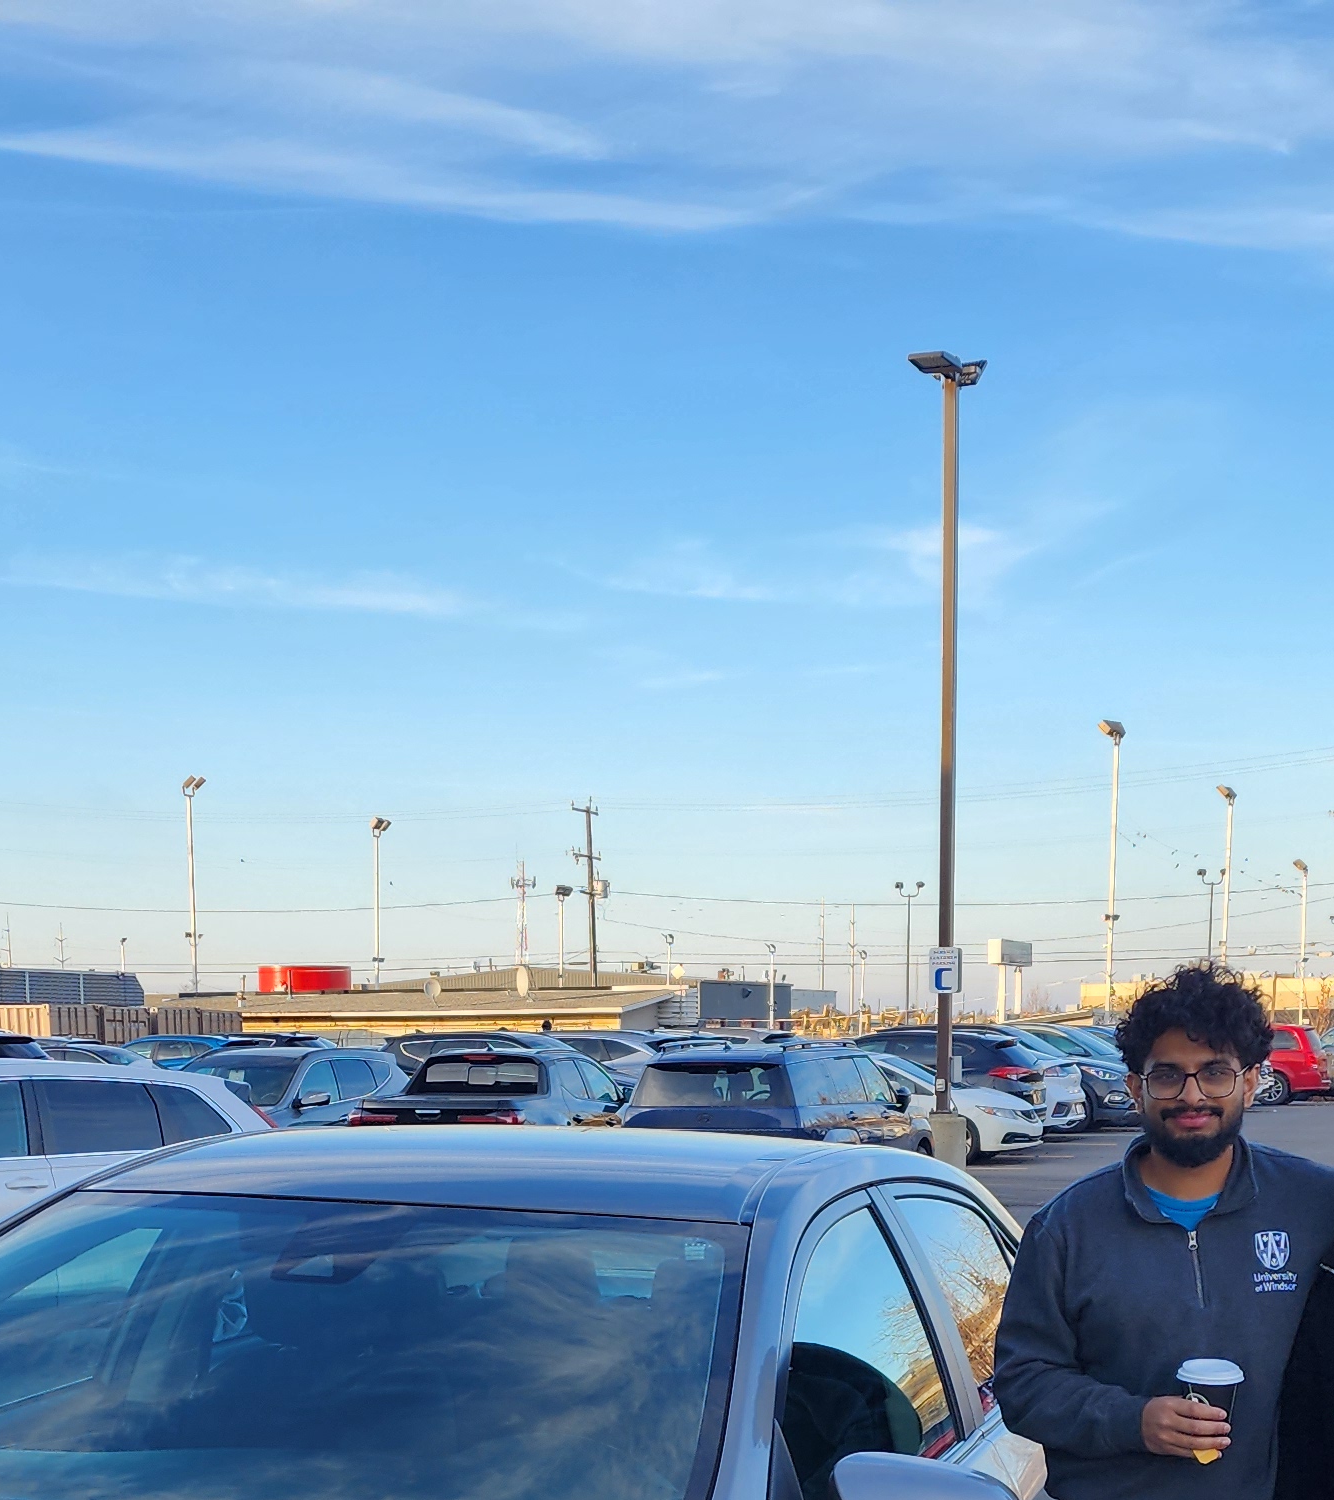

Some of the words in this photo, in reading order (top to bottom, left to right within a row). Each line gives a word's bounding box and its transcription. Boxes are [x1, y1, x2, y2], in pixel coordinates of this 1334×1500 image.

[935, 967, 953, 990] C
[1253, 1271, 1298, 1283] University
[1263, 1281, 1298, 1292] Windsor
